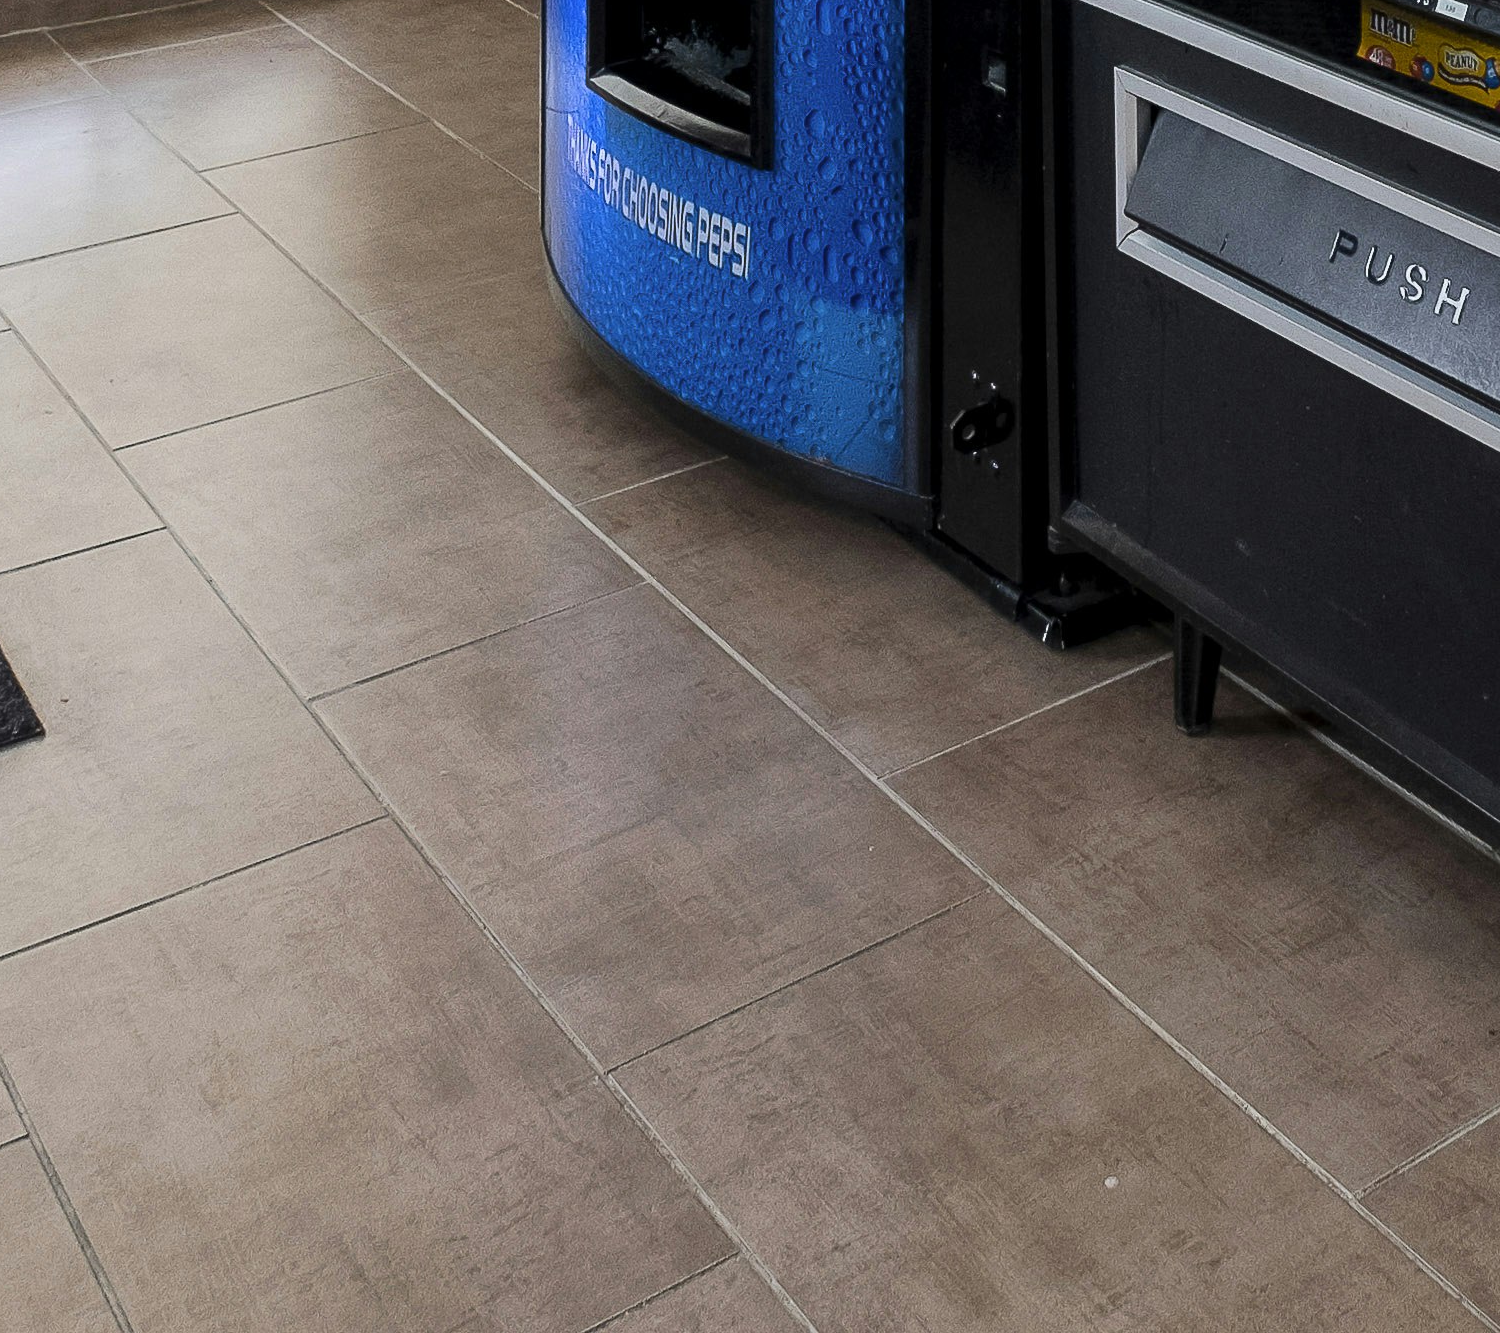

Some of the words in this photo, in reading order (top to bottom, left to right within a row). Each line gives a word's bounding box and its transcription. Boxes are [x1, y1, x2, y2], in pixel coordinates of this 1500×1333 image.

[1444, 51, 1480, 72] PEANUT
[597, 148, 620, 210] FOR
[621, 167, 695, 257] CHOOSING
[697, 206, 751, 281] PEPSI
[1328, 228, 1471, 325] PUSH
